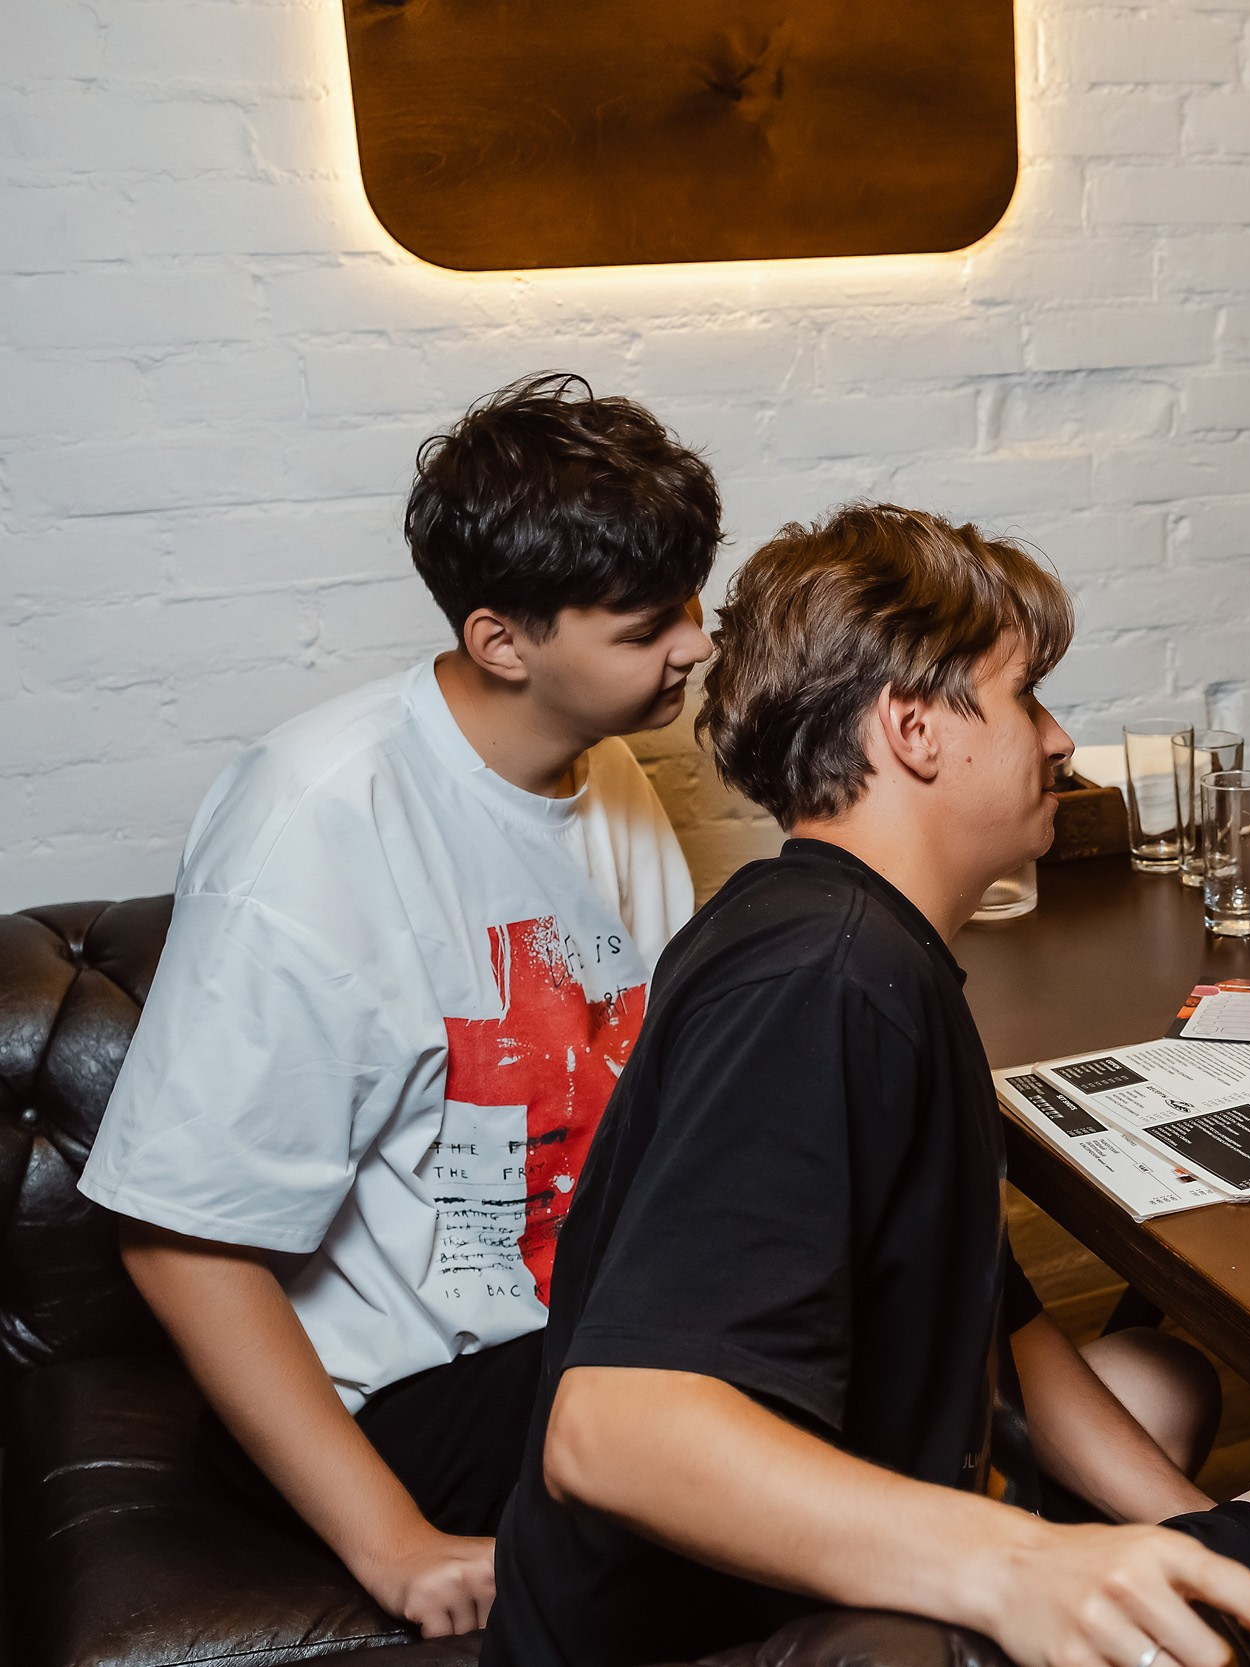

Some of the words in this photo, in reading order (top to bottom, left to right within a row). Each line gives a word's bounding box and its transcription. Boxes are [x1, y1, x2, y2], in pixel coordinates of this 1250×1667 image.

[433, 1166, 468, 1180] THE
[503, 1161, 545, 1180] FRAY
[486, 1283, 544, 1298] BACK
